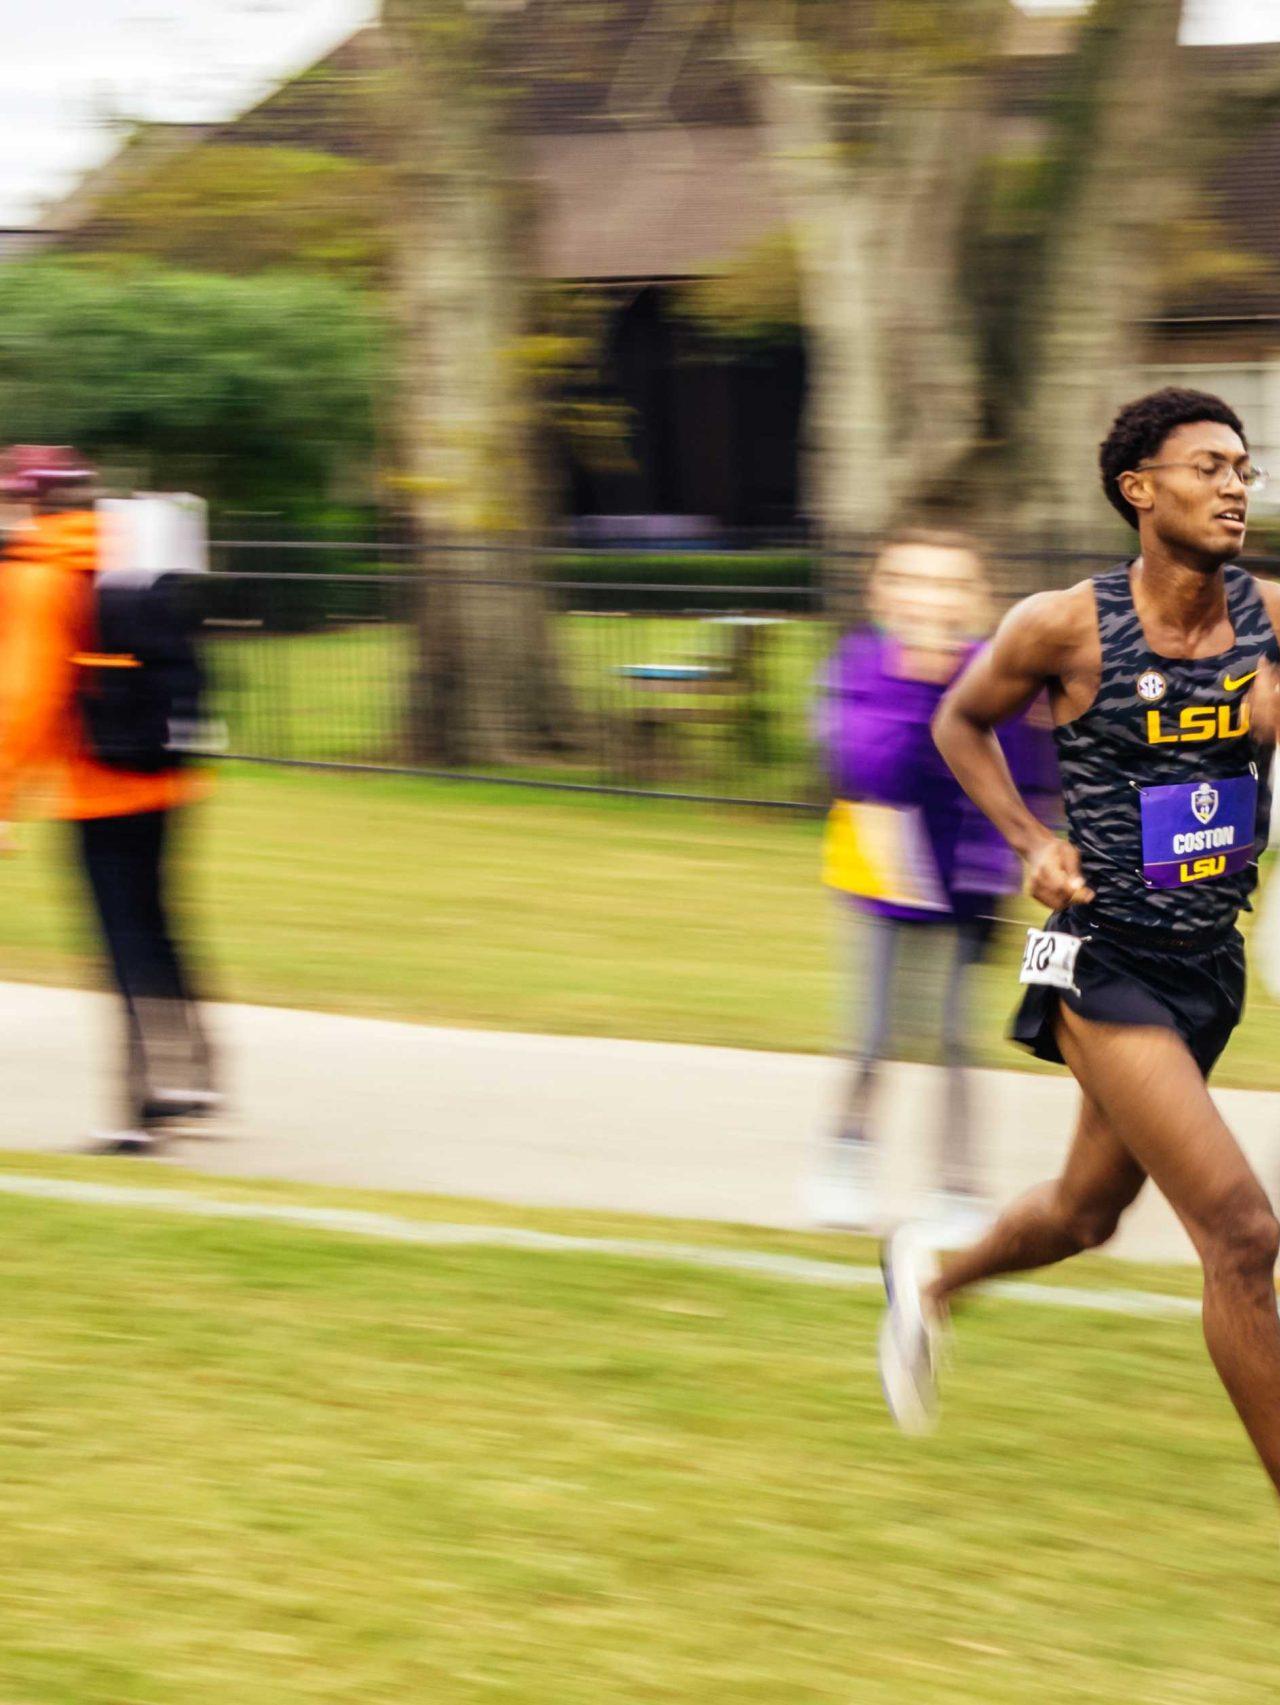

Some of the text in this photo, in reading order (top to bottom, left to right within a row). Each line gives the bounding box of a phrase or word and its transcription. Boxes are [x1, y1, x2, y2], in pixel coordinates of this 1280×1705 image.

[1147, 704, 1249, 744] LSU
[1173, 825, 1235, 855] COSTON
[1180, 855, 1226, 883] LSU
